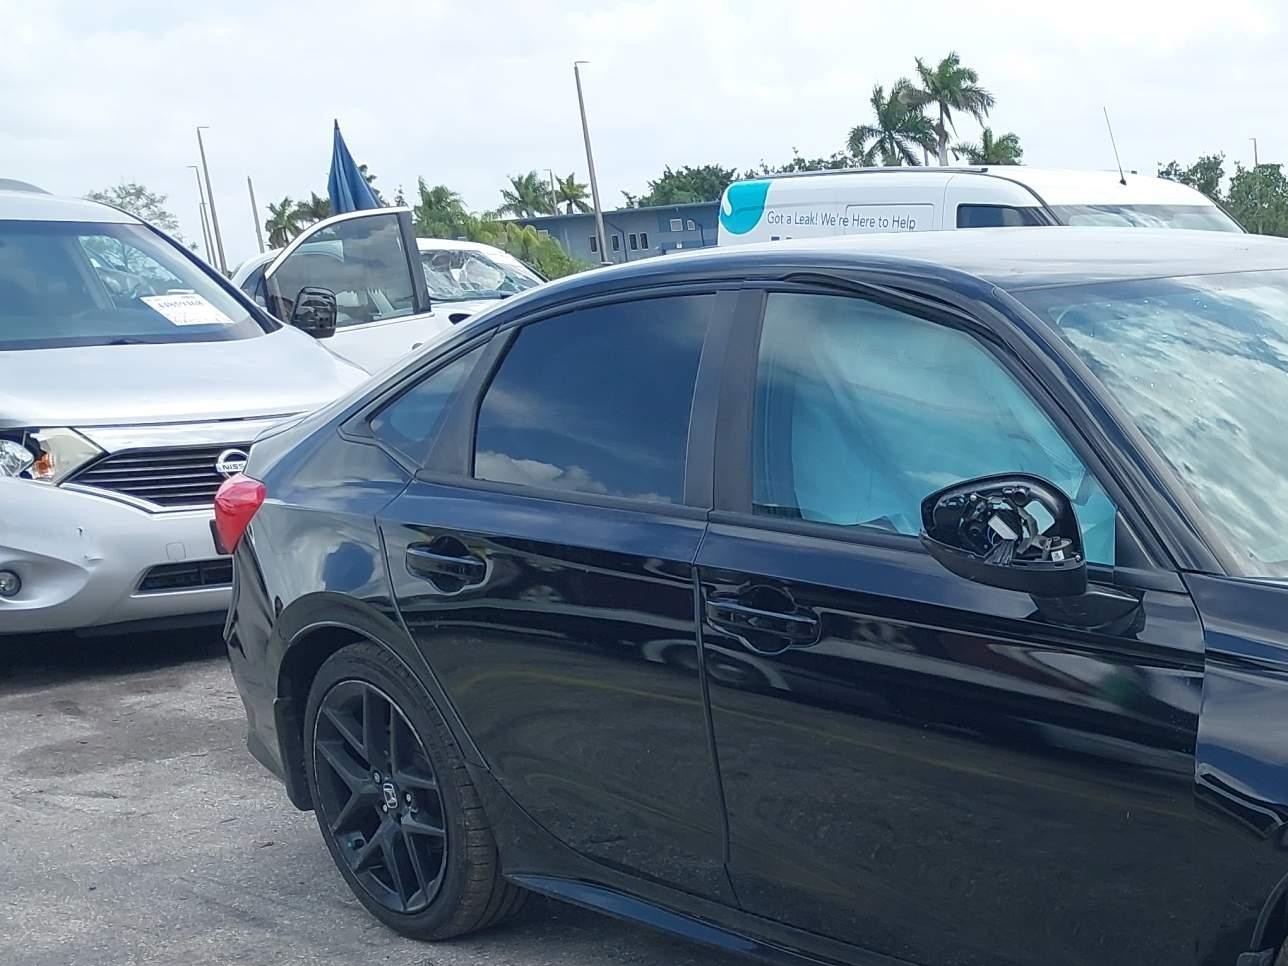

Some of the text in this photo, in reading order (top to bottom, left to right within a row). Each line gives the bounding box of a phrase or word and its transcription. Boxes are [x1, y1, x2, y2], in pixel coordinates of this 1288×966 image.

[767, 211, 916, 230] Got a Leak! We're Here to Help
